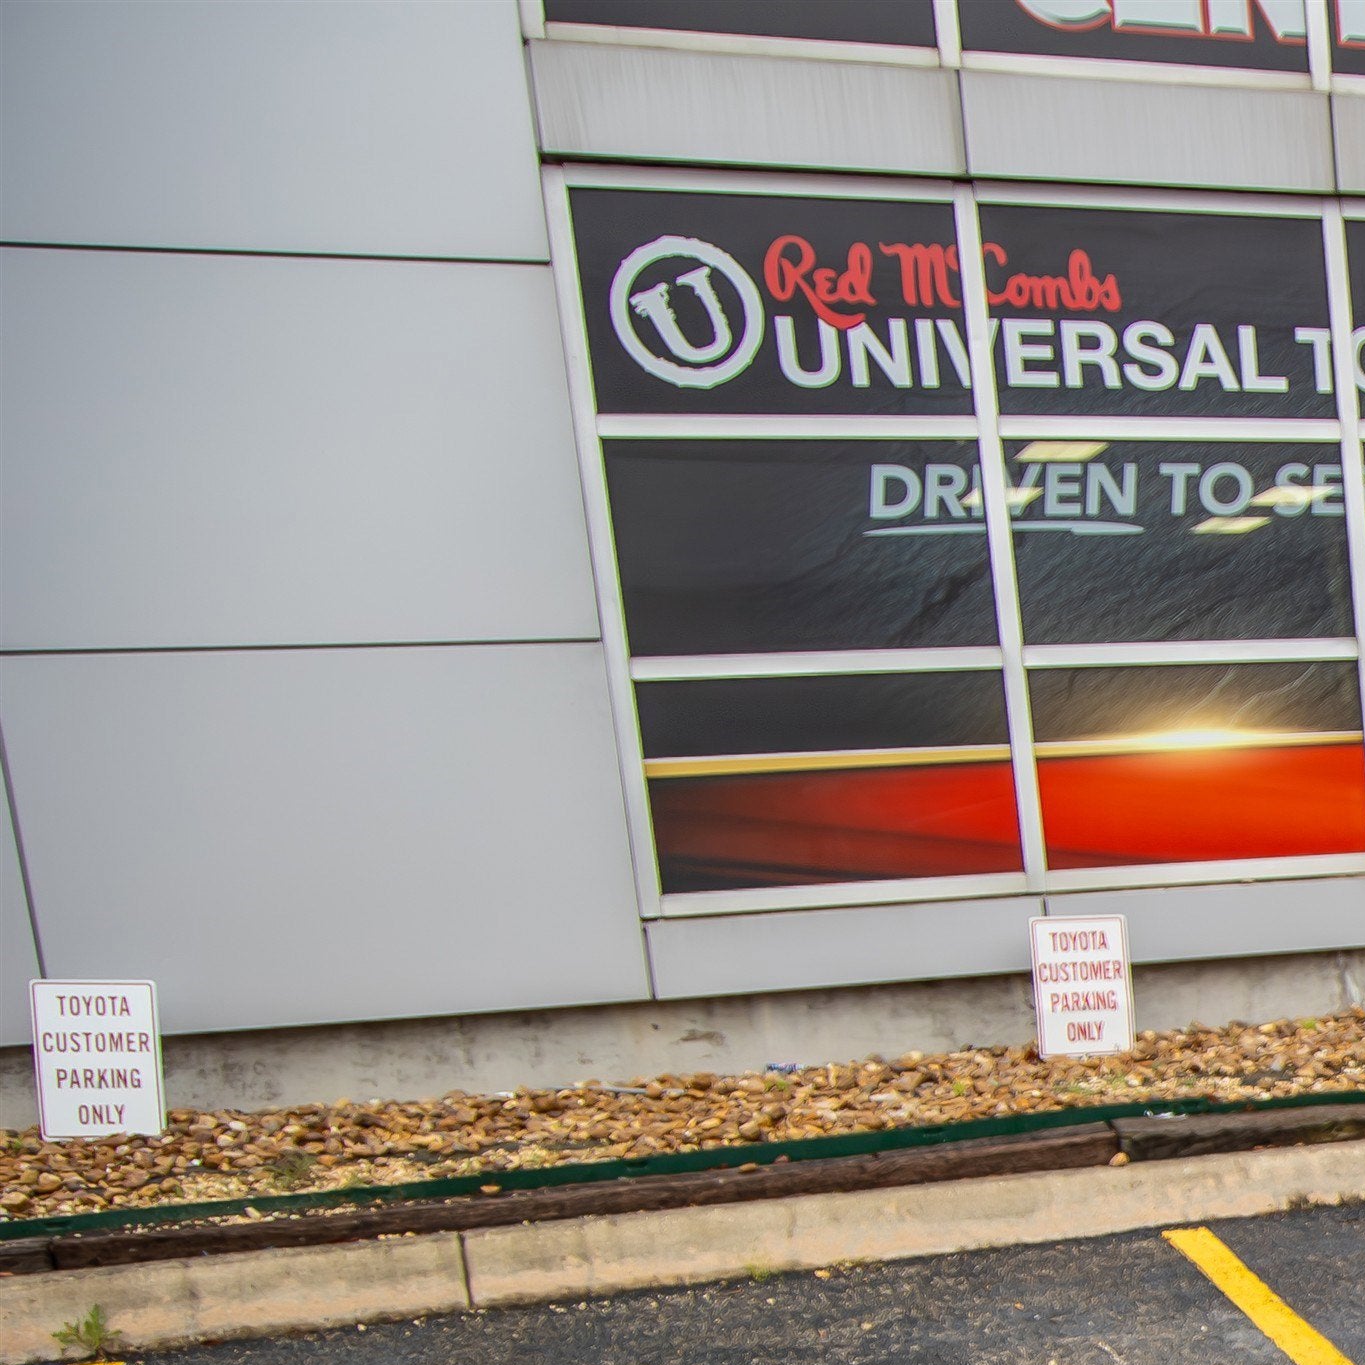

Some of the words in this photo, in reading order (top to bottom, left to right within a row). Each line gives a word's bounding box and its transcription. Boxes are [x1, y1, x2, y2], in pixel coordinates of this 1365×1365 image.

[764, 234, 877, 330] Red
[774, 314, 1289, 393] UNIVERSAL
[1159, 461, 1255, 517] TO
[1050, 930, 1108, 952] TOYOTA
[1038, 960, 1123, 982] CUSTOMER
[56, 995, 131, 1017] TOYOTA
[1050, 990, 1117, 1012] PARKING
[1066, 1020, 1105, 1042] ONLY
[42, 1032, 150, 1053] CUSTOMER
[56, 1068, 142, 1090] PARKING
[78, 1104, 126, 1125] ONLY
